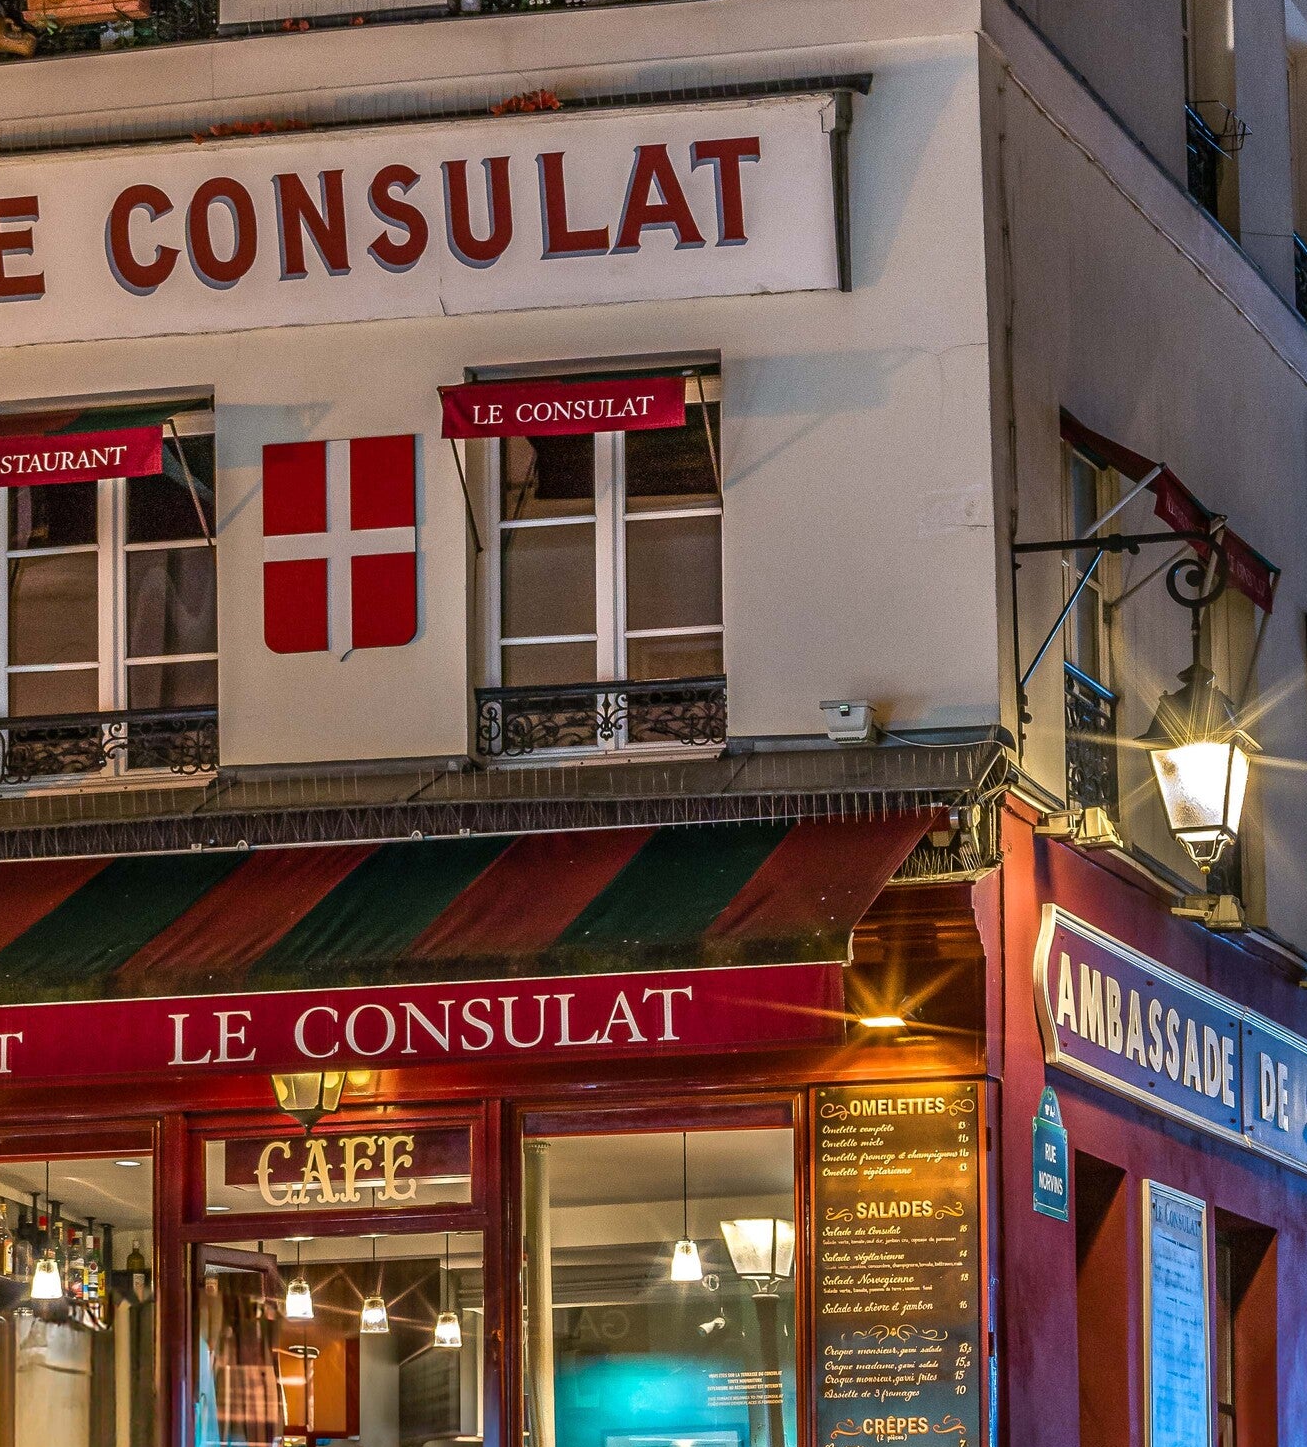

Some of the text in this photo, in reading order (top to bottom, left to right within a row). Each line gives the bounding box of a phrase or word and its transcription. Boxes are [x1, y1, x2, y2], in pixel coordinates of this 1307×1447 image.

[104, 136, 761, 297] CONSULAT
[472, 394, 654, 426] LE CONSULAT
[167, 985, 693, 1066] LE CONSULAT
[1056, 951, 1236, 1109] AMBASSADE
[1260, 1051, 1290, 1132] DE
[849, 1097, 946, 1117] OMELETTES
[822, 1125, 857, 1135] Omelette
[822, 1138, 858, 1148] Omelette
[822, 1153, 858, 1162] Omelette
[859, 1152, 896, 1166] fromage
[1044, 1142, 1057, 1164] RUE
[822, 1167, 859, 1177] Omelette
[1038, 1170, 1064, 1196] NORVINS
[856, 1200, 934, 1219] SALADES
[822, 1226, 852, 1236] Salade
[854, 1227, 866, 1236] du
[822, 1252, 851, 1262] Salade
[823, 1275, 854, 1286] Salade
[822, 1302, 852, 1314] Salade
[853, 1301, 864, 1313] de
[864, 1301, 891, 1313] chèvre
[900, 1300, 934, 1316] jambon
[824, 1345, 854, 1362] Croque
[824, 1360, 854, 1376] Croque
[825, 1374, 854, 1388] Croque
[954, 1370, 966, 1380] 15
[824, 1384, 967, 1403] Assiette de 3 fromages 10
[862, 1415, 930, 1435] CRÊPES
